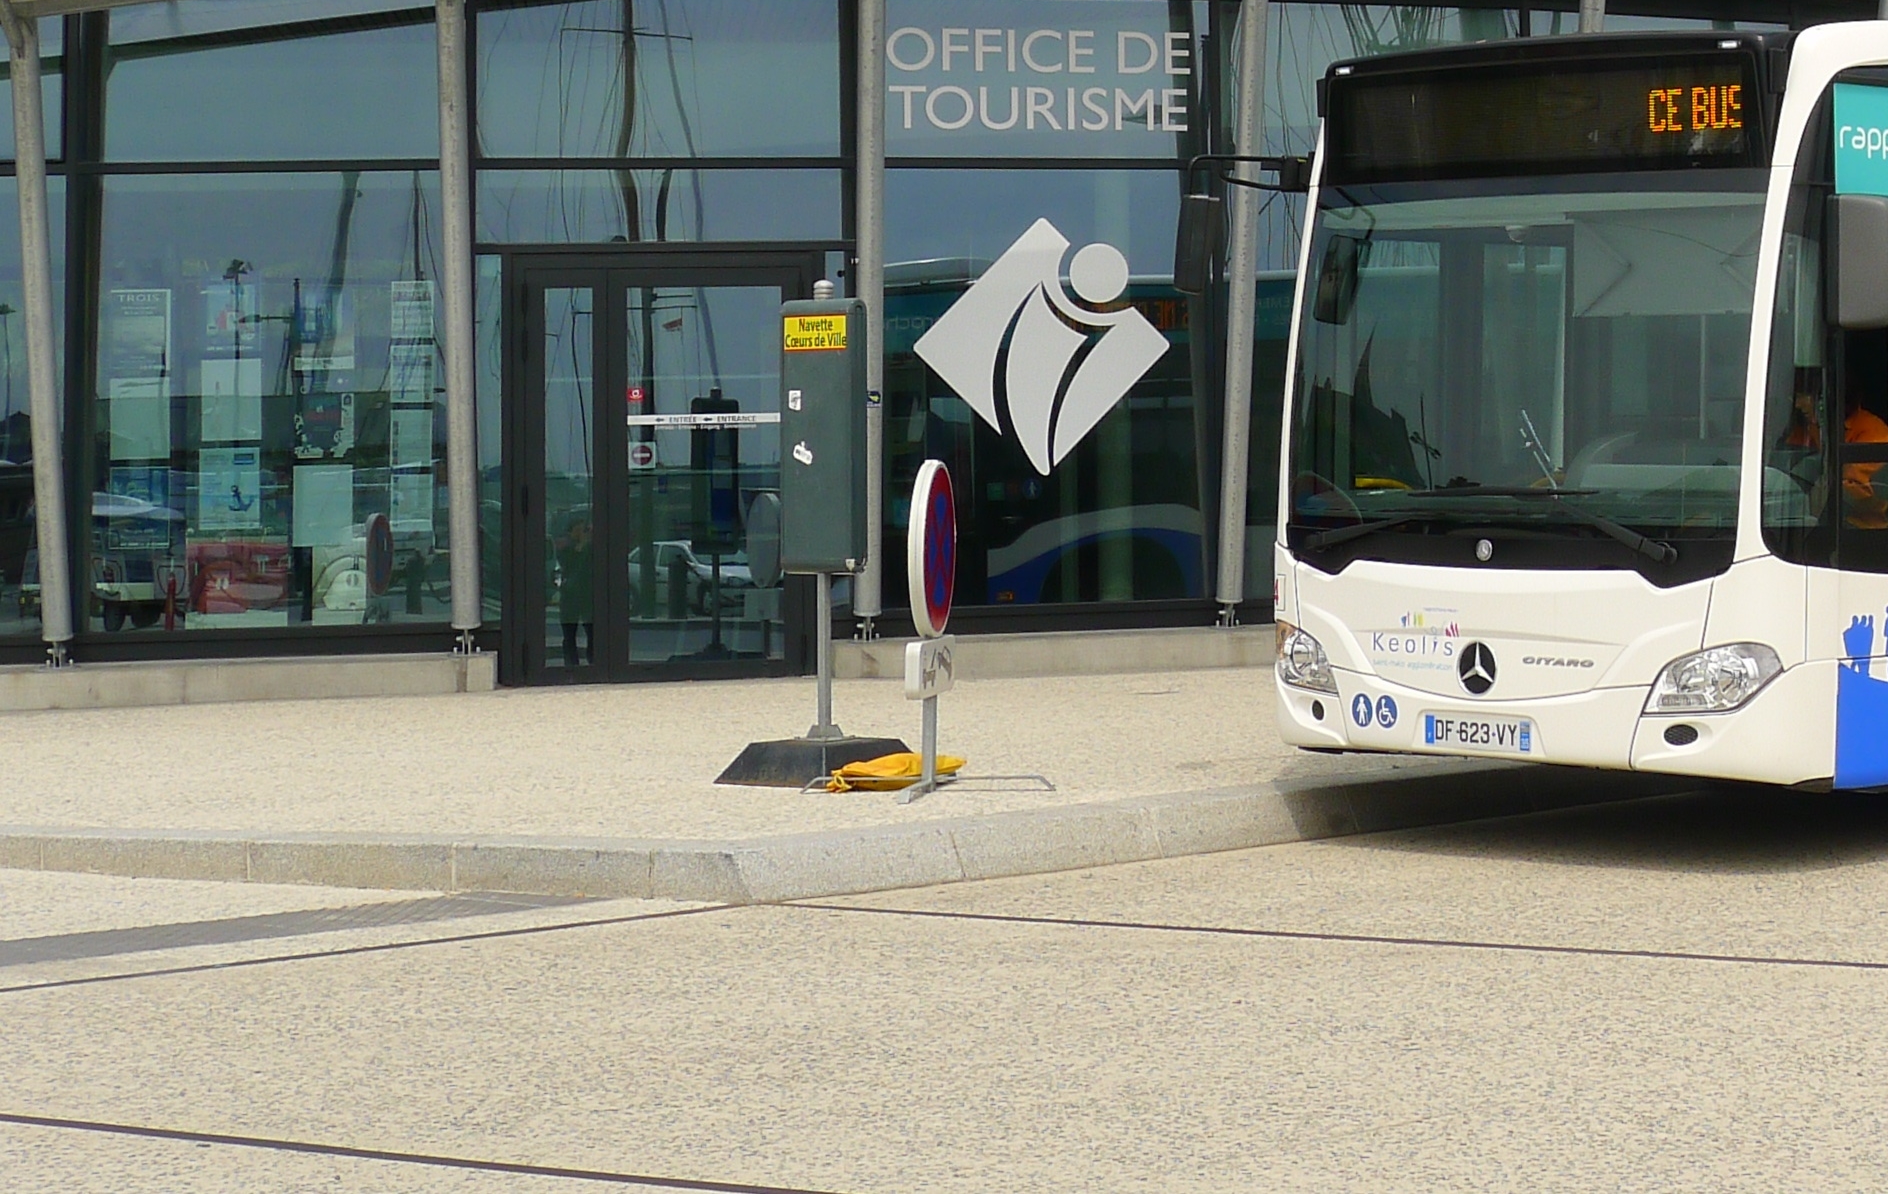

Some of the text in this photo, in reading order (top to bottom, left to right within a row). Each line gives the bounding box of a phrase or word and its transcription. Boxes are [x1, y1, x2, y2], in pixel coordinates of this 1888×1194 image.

[886, 26, 1191, 75] OFFICE DE
[888, 85, 1188, 132] TOURISME
[1649, 85, 1741, 132] CE BUS
[785, 332, 848, 348] Cœurs de Ville
[798, 318, 833, 332] Navette
[1373, 631, 1454, 656] Keolis
